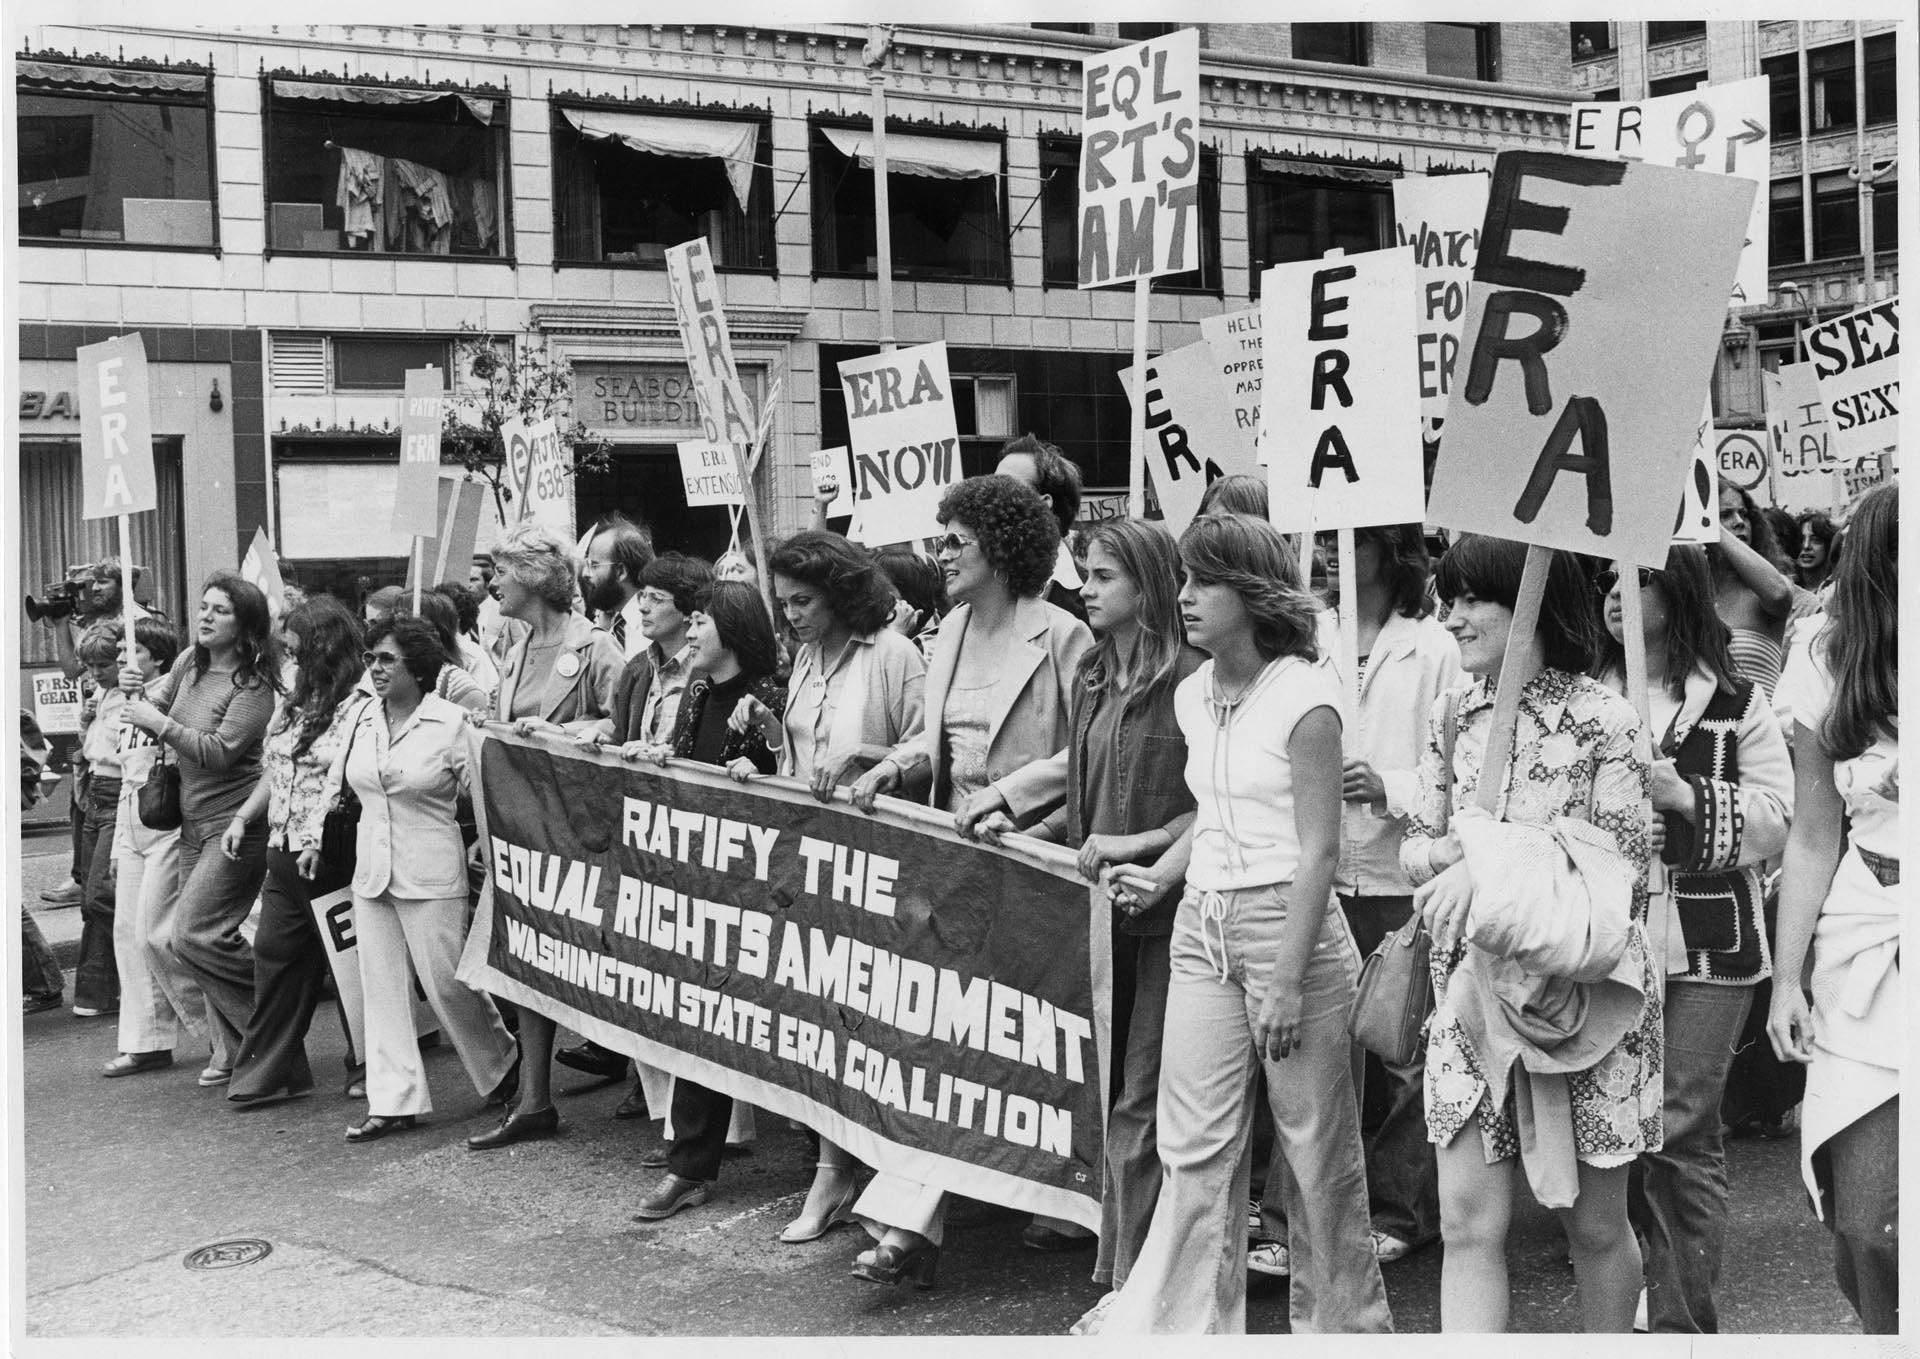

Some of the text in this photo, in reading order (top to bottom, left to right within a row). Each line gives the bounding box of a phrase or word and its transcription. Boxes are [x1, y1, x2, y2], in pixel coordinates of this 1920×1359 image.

[1086, 46, 1182, 120] EQ'L
[1085, 112, 1195, 192] RT'S
[1079, 179, 1198, 284] AM'T
[686, 243, 753, 443] ERA
[1240, 337, 1263, 351] THE
[1307, 265, 1360, 488] ERA
[1464, 150, 1628, 537] ERA
[19, 391, 80, 420] BA
[843, 359, 944, 419] ERA
[97, 357, 133, 508] ERA
[406, 433, 436, 462] ERA
[701, 451, 728, 467] ERA
[856, 438, 956, 500] NOW
[1721, 451, 1760, 470] ERA
[537, 464, 564, 500] 638
[40, 691, 78, 705] GEAR
[622, 796, 899, 917] RATIFY THE
[491, 835, 1092, 1084] EQUAL RIGHTS AMENDMENT
[505, 915, 1072, 1158] WASHINGTON STATE ERA COALITION
